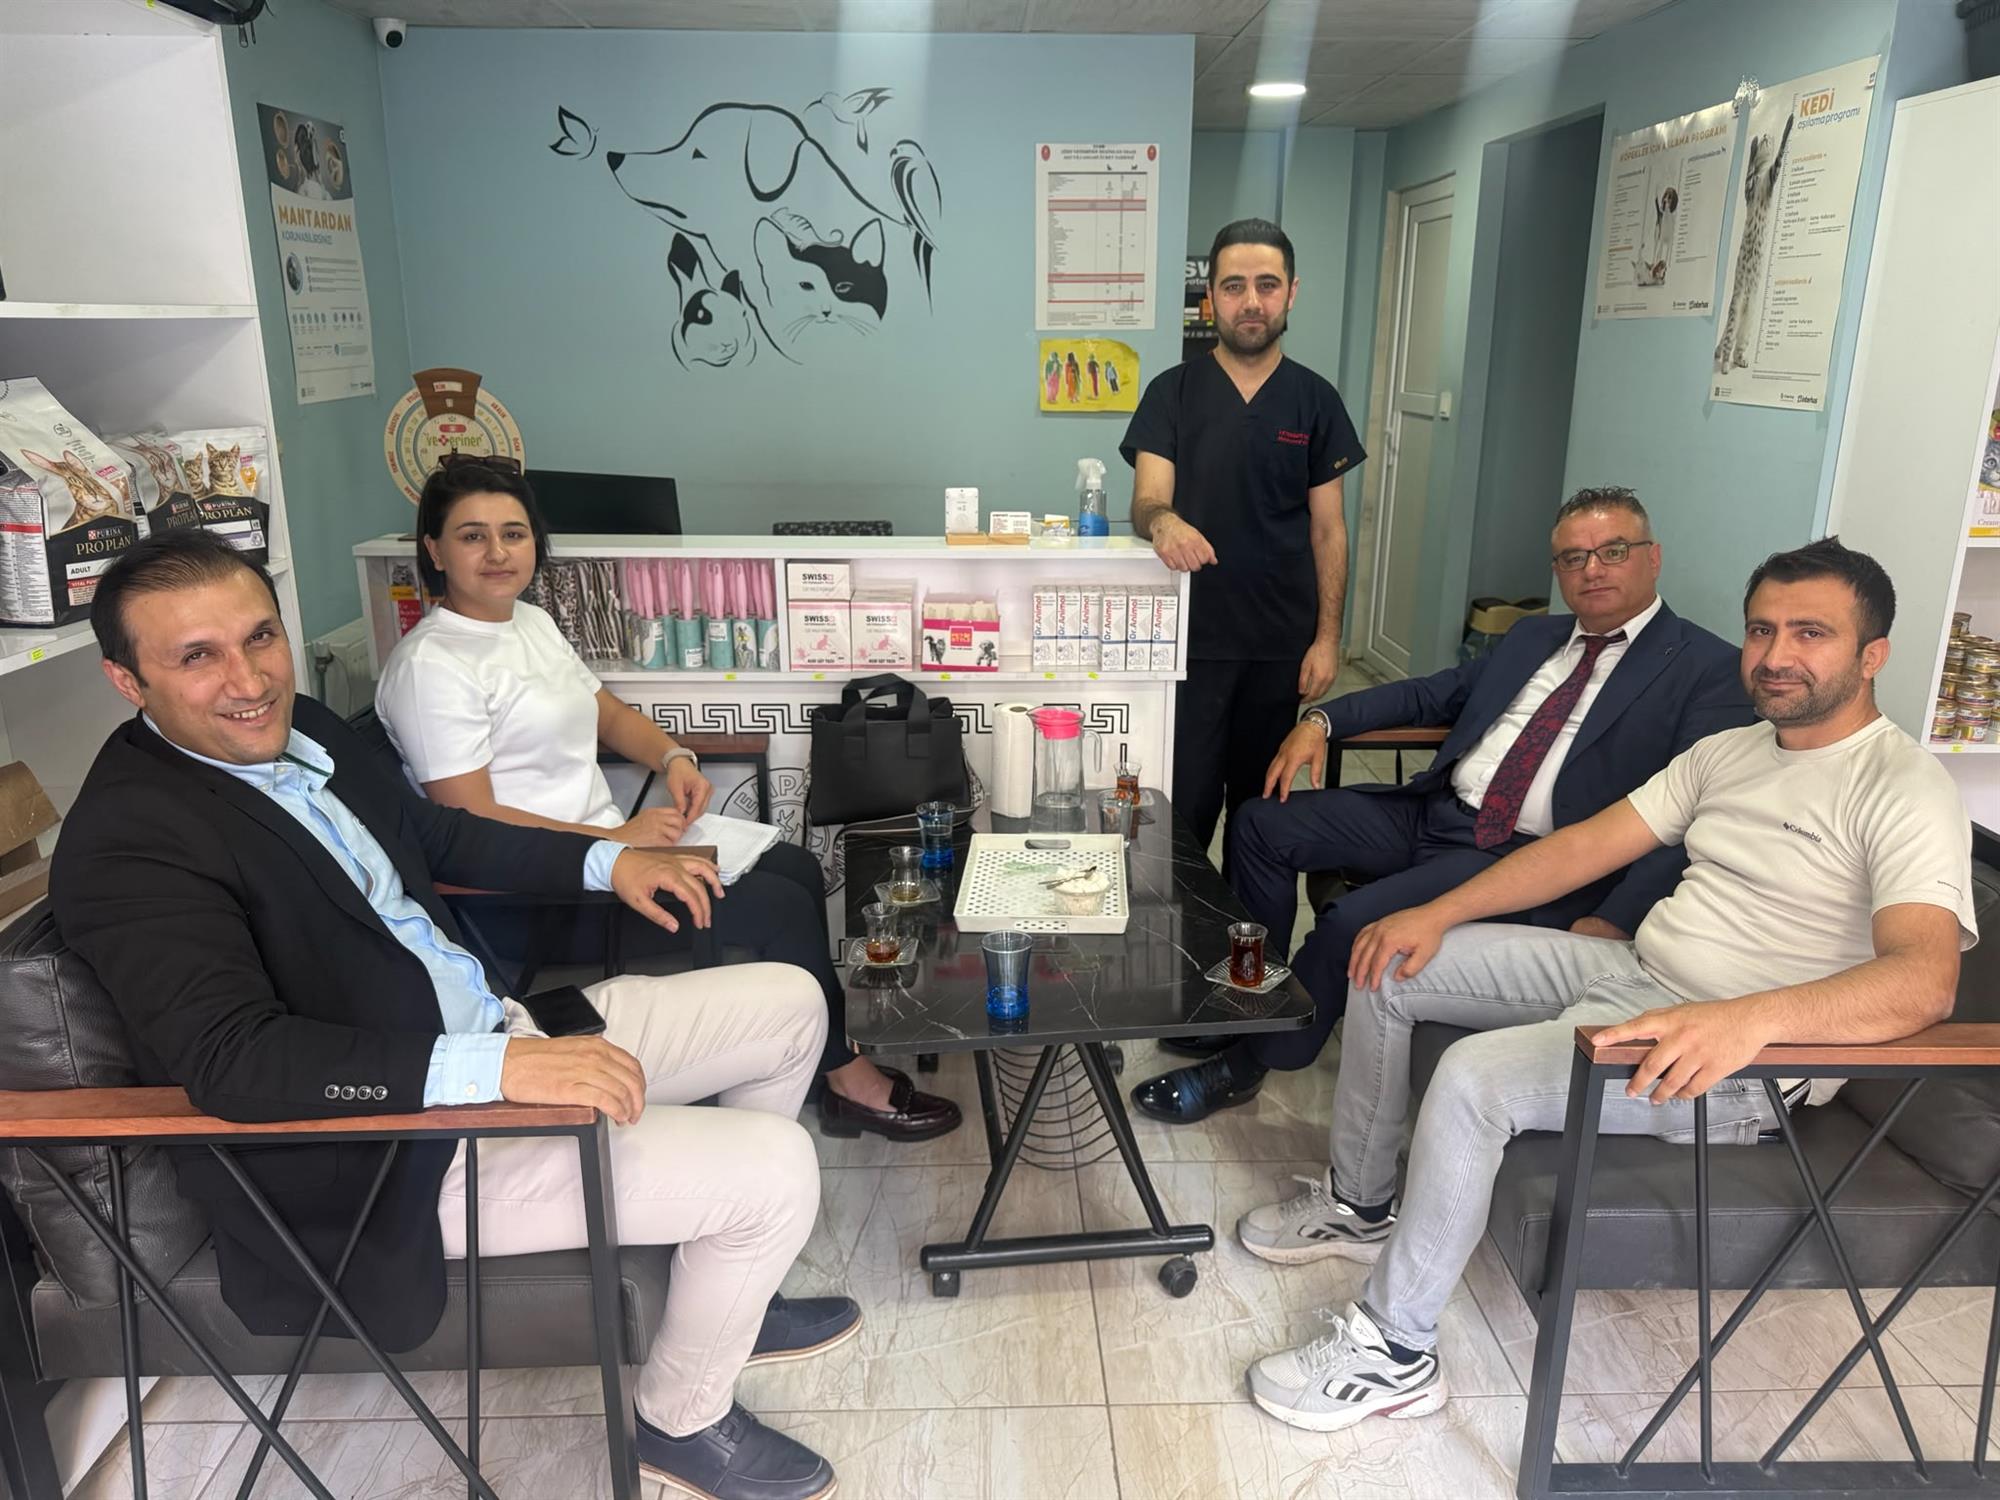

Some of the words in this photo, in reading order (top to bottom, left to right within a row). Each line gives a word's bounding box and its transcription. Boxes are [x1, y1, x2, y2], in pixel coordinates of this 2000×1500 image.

[1799, 87, 1836, 118] KEDİ
[278, 205, 352, 232] MANTARDAN
[222, 506, 253, 518] PLAN
[96, 527, 122, 538] PURINA
[76, 541, 104, 555] PRO
[106, 535, 131, 551] PLAN
[70, 566, 91, 575] ADULT
[802, 573, 828, 581] SWISS
[866, 615, 891, 623] SWISS
[1789, 824, 1822, 843] Columbia
